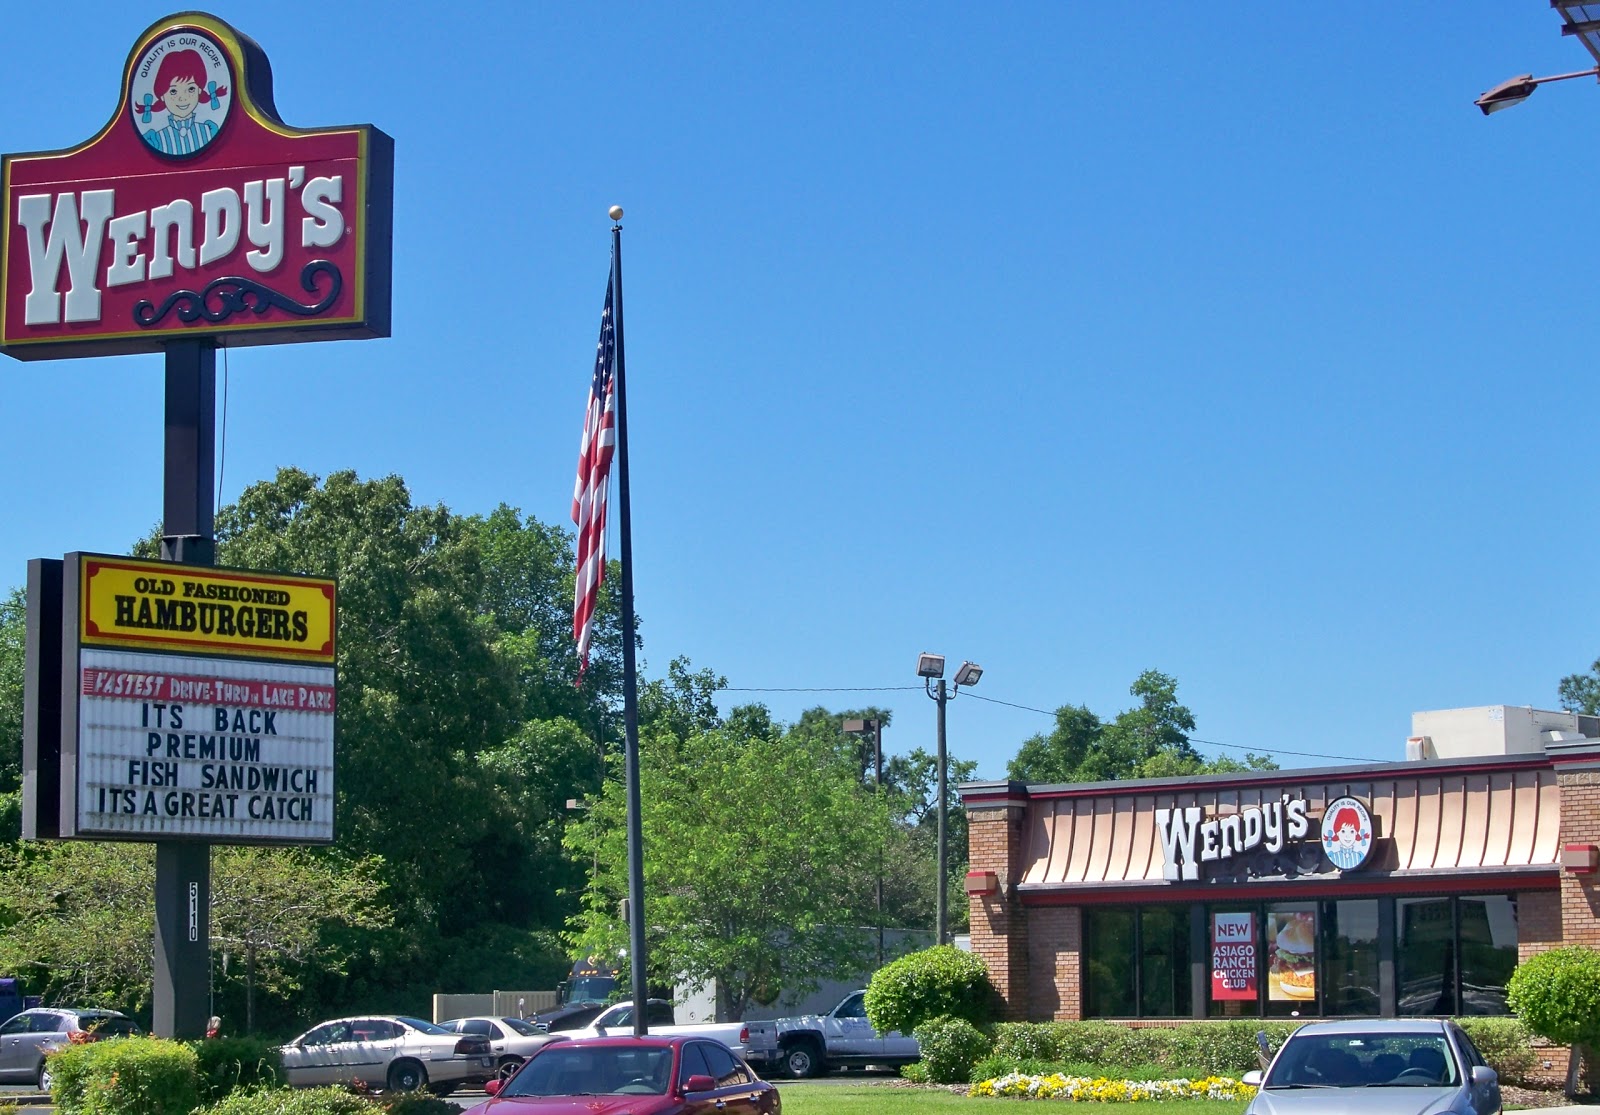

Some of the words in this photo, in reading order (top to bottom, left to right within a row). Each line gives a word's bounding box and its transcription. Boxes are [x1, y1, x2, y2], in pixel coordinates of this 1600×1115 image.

[141, 45, 165, 78] QUALITY
[167, 39, 176, 49] IS
[179, 37, 197, 46] OUR
[199, 42, 221, 68] RECIPE
[134, 577, 175, 595] OLD
[183, 582, 290, 606] FASHIONED
[115, 595, 308, 642] HAMBURGERS
[93, 672, 165, 696] FASTEST
[262, 684, 295, 706] LAKE
[298, 687, 331, 709] PARK
[142, 702, 183, 729] ITS
[215, 707, 277, 735] BACK
[147, 733, 260, 762] PREMIUM
[128, 760, 179, 787] FISH
[201, 764, 317, 793] SANDWICH
[164, 791, 239, 818] GREAT
[248, 794, 313, 822] CATCH
[1327, 803, 1340, 821] QUALITY
[1217, 923, 1248, 937] NEW
[1213, 945, 1254, 957] ASIAGO
[1213, 957, 1255, 969] RANCH
[1213, 969, 1255, 979] CHICKEN
[1222, 979, 1246, 989] CLUB
